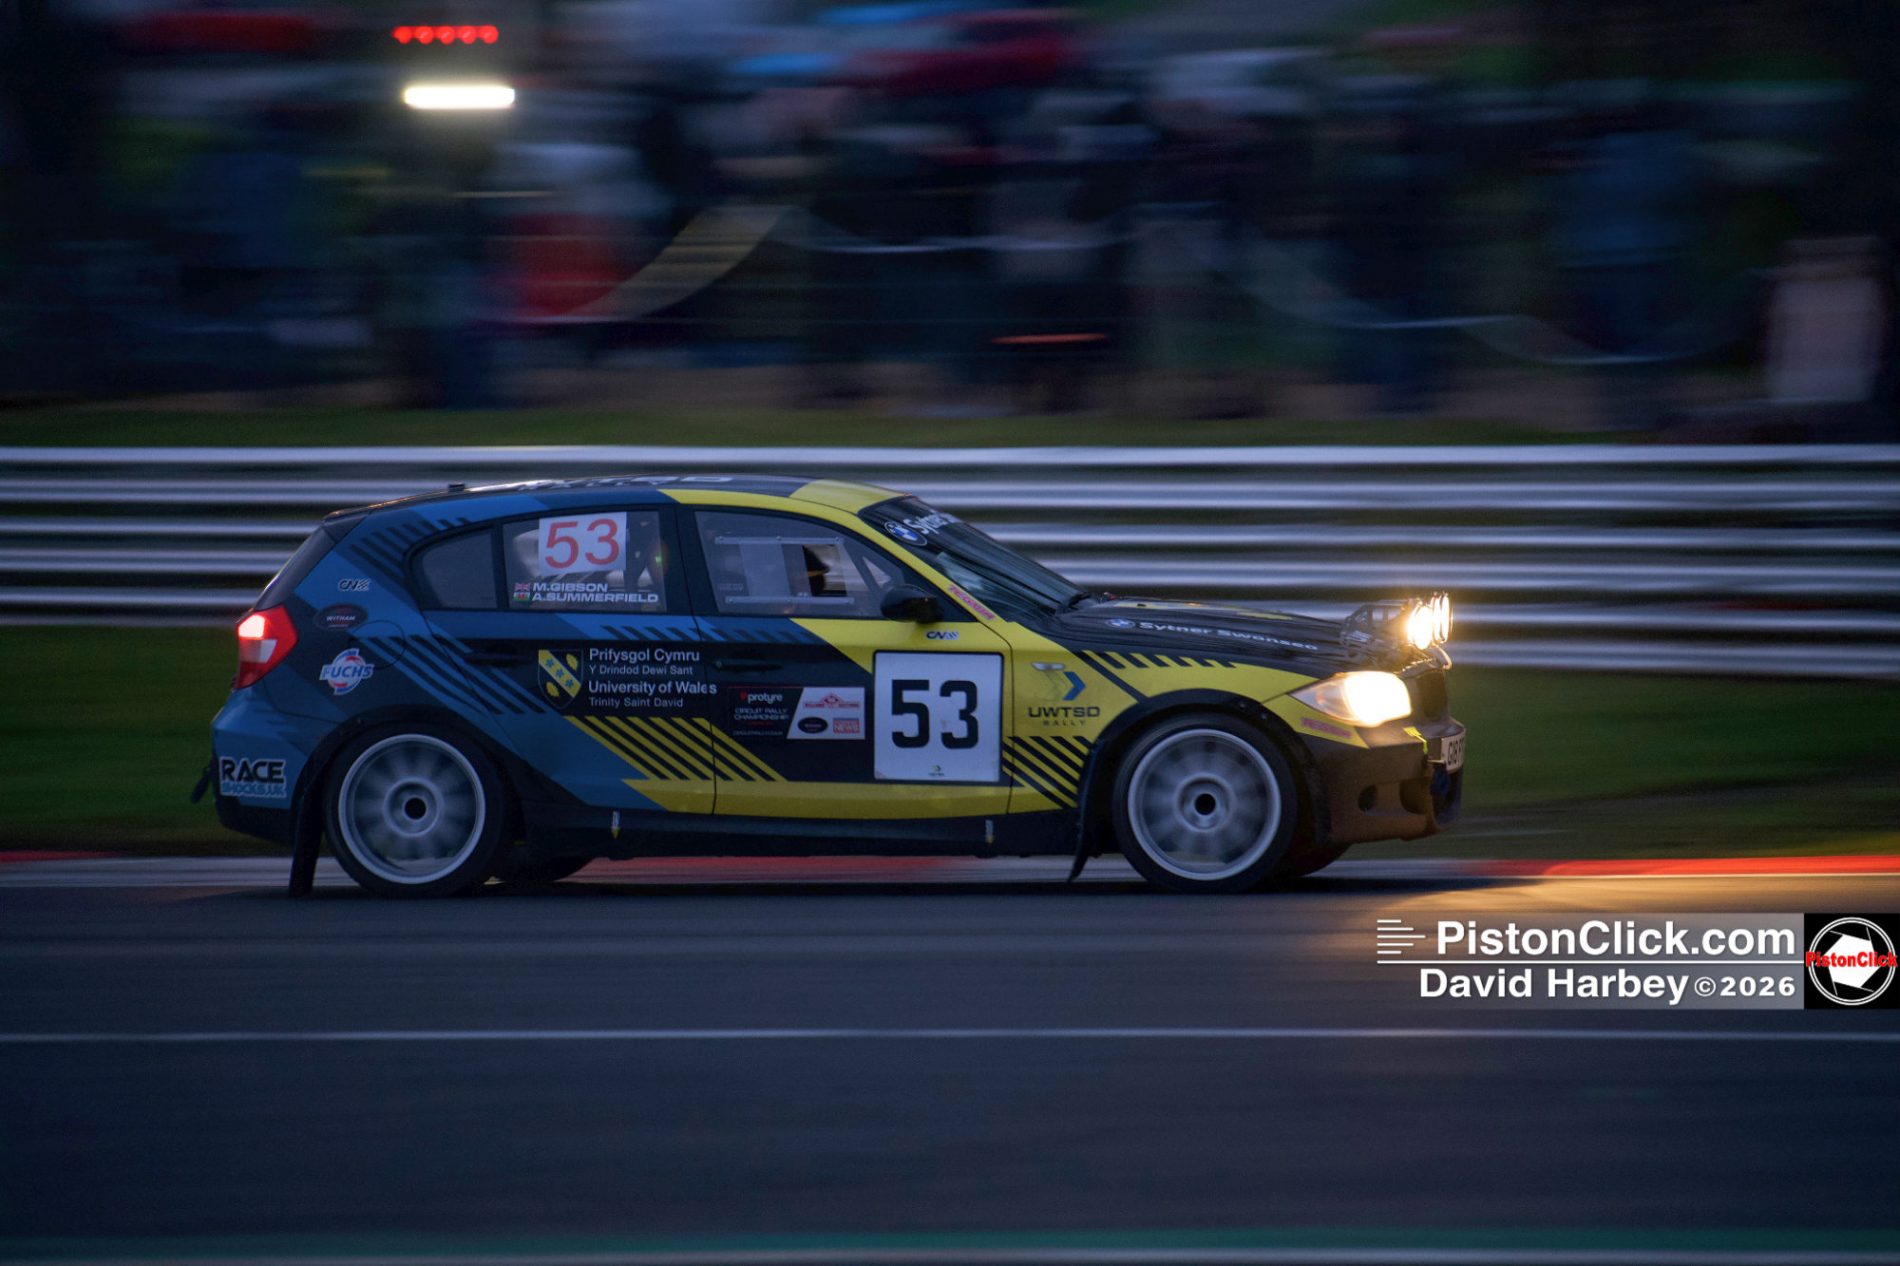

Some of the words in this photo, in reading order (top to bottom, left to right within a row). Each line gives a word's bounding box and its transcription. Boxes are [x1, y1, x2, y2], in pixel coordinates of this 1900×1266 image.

[545, 518, 620, 569] 53
[532, 582, 608, 592] M.GIBSON
[531, 592, 659, 603] A.SUMMERFIELD
[1138, 621, 1213, 635] Sytner
[589, 647, 650, 664] Prifysgol
[654, 648, 700, 664] Cymru
[323, 665, 371, 678] FUCHS
[589, 665, 597, 675] Y
[599, 664, 639, 675] Drindod
[642, 664, 667, 675] Dewi
[670, 665, 693, 675] Sant
[588, 680, 655, 696] University
[658, 681, 673, 694] of
[675, 681, 718, 694] Wales
[589, 697, 620, 708] Trinity
[624, 697, 651, 708] Saint
[654, 697, 684, 708] David
[747, 692, 783, 704] protyre
[891, 679, 979, 749] 53
[1028, 706, 1100, 718] UWTSD
[222, 759, 284, 783] RACE
